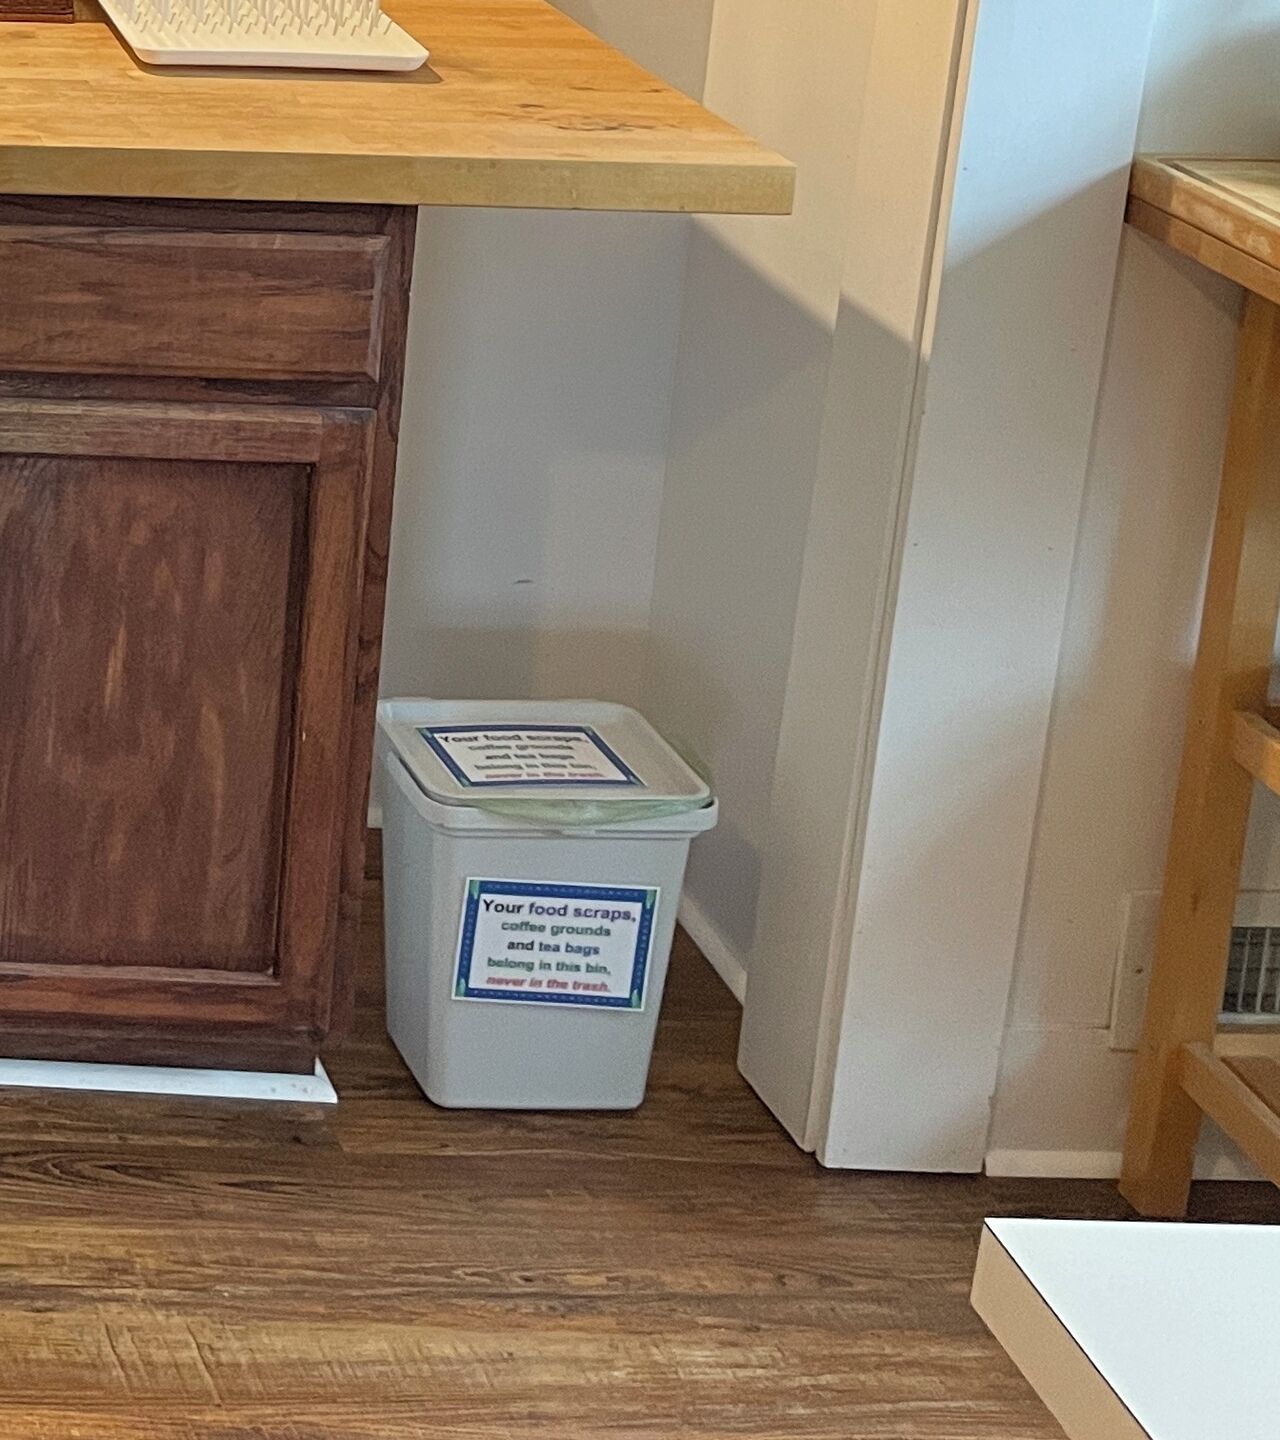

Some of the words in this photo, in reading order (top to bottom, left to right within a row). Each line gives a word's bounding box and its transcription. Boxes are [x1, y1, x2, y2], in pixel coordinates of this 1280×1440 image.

[439, 734, 479, 743] Your
[482, 733, 522, 742] food
[483, 898, 524, 914] Your
[528, 902, 568, 917] food
[501, 920, 546, 932] coffee
[550, 923, 611, 937] grounds
[507, 940, 535, 951] and
[538, 941, 561, 953] tea
[565, 942, 600, 957] bags
[486, 956, 535, 972] belong
[538, 959, 552, 971] in
[555, 961, 581, 972] this
[486, 976, 528, 987] never
[528, 978, 543, 988] in
[546, 979, 569, 990] the
